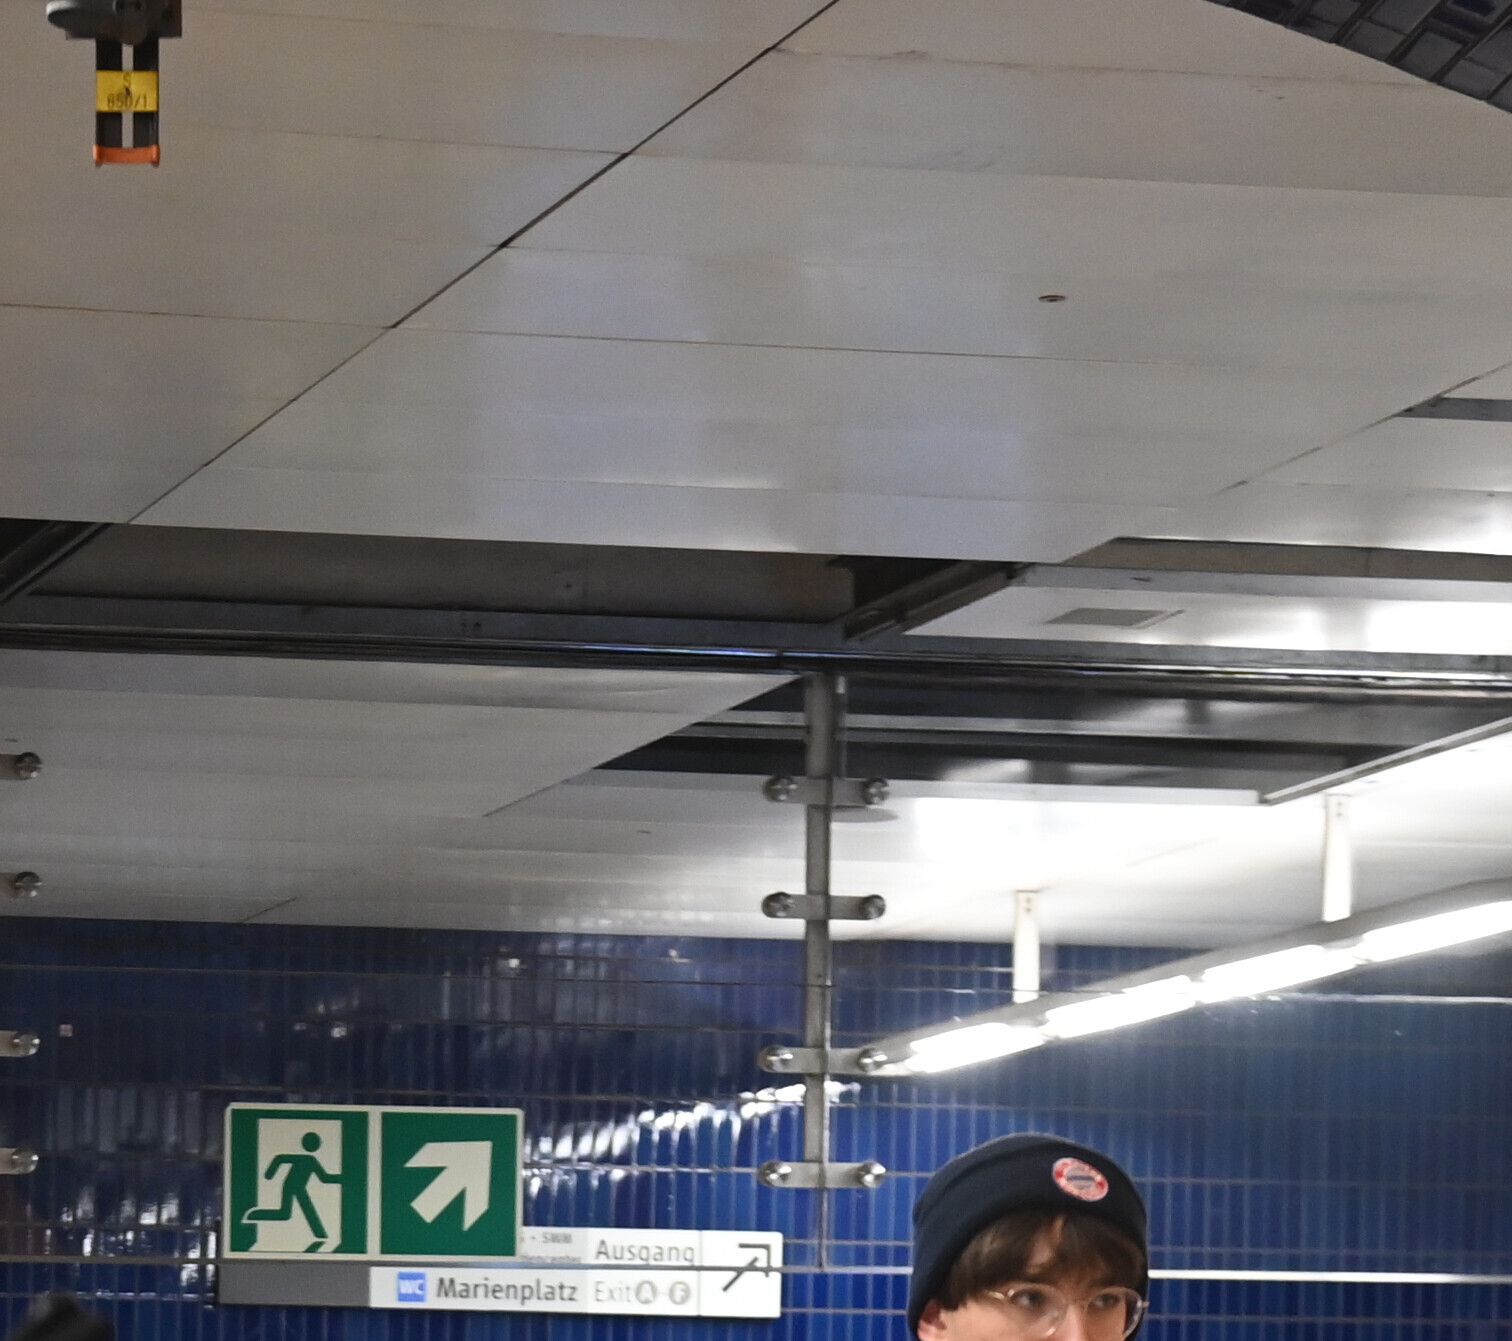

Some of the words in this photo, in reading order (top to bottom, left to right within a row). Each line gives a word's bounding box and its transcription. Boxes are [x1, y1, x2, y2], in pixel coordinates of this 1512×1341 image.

[594, 1238, 696, 1266] Ausgang
[399, 1279, 425, 1296] WC
[436, 1277, 579, 1306] Marienplatz
[594, 1280, 632, 1303] Exit
